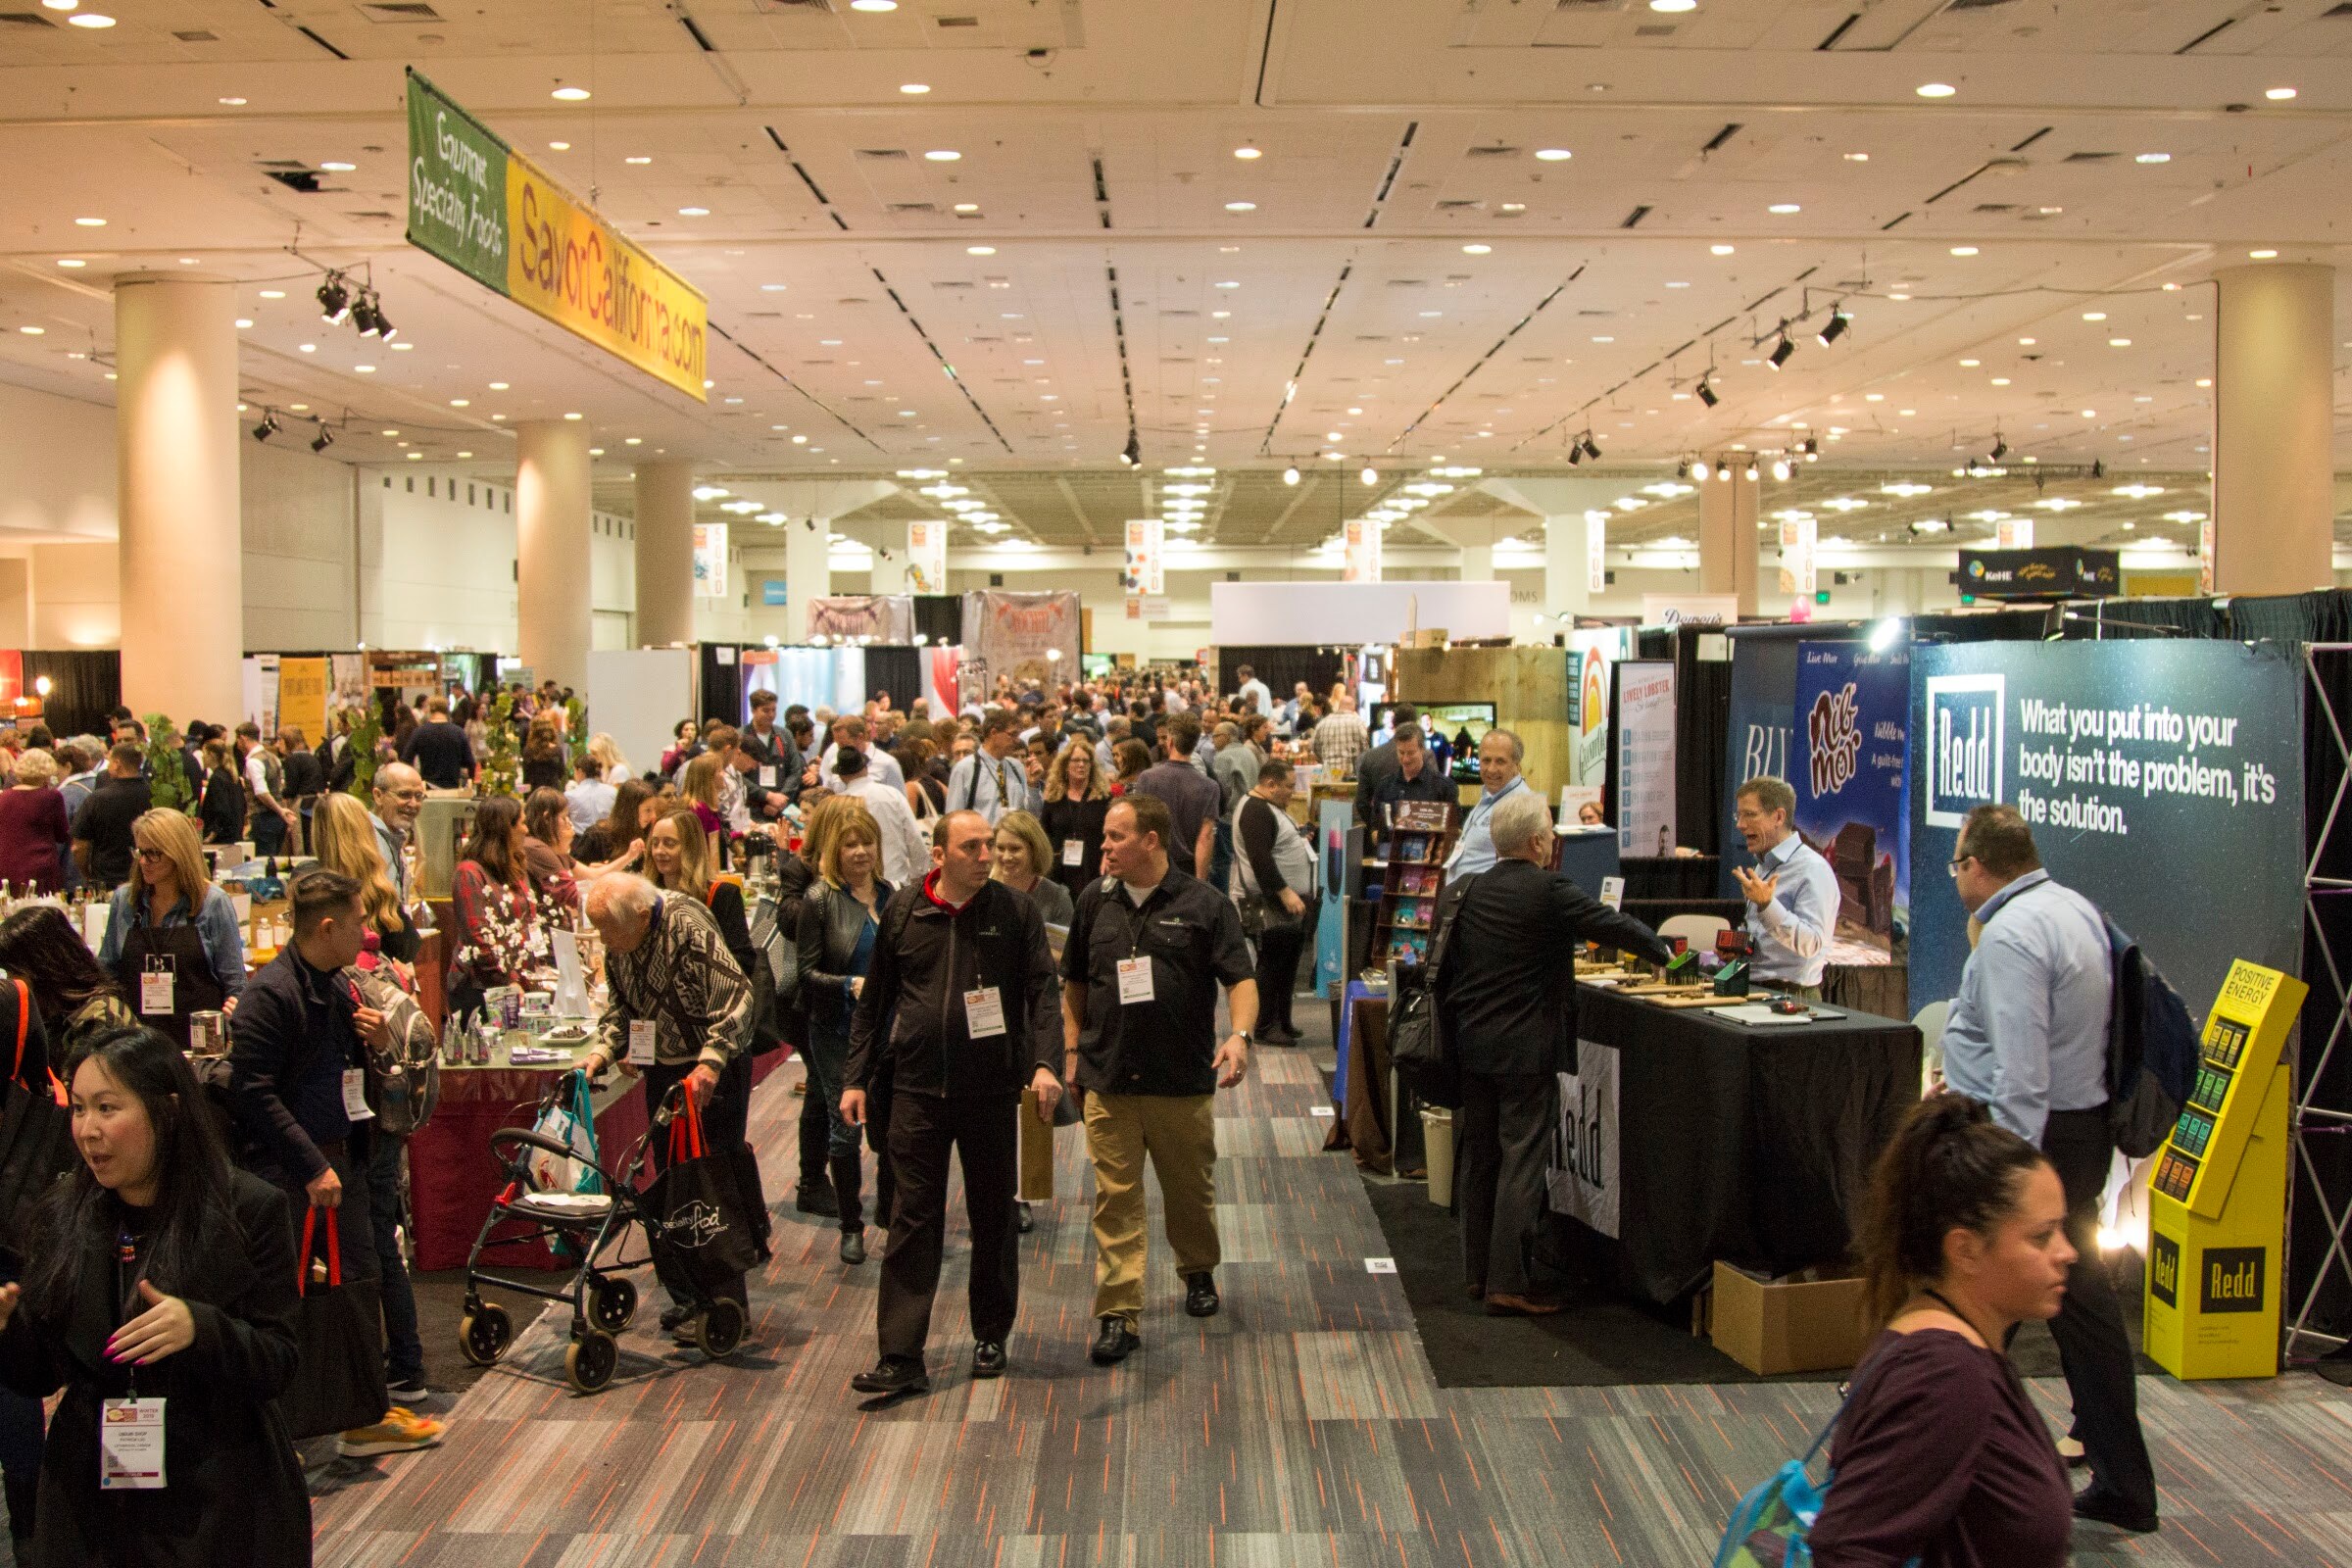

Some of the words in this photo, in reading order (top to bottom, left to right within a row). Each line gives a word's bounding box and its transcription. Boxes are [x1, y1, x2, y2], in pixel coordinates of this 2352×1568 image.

[2020, 699, 2068, 733] What
[2070, 710, 2104, 743] you
[2107, 705, 2141, 746] put
[2144, 706, 2182, 743] into
[2186, 716, 2237, 753] your
[2020, 744, 2063, 788] body
[2066, 747, 2106, 785] isn't
[2108, 750, 2139, 788] the
[2143, 757, 2238, 807] problem,
[2243, 761, 2277, 804] it's
[2019, 788, 2046, 823] the
[2049, 794, 2129, 834] solution.
[2225, 981, 2268, 1005] ENERGY
[2231, 965, 2276, 991] POSITIVE
